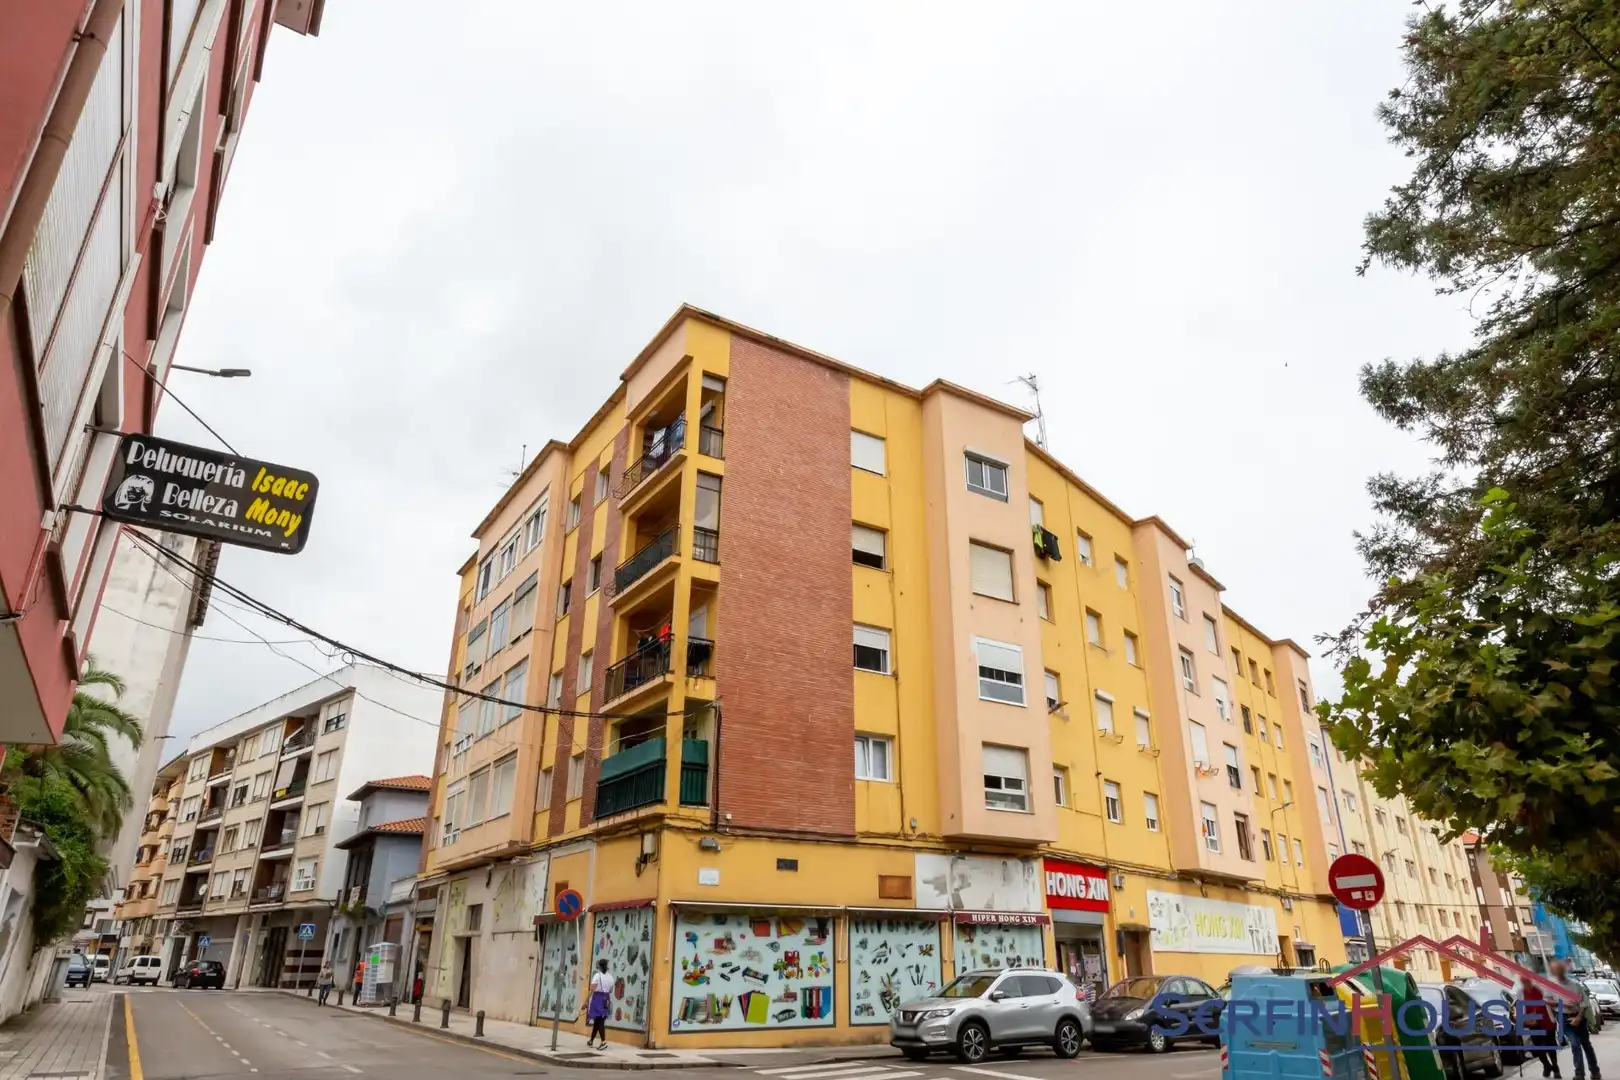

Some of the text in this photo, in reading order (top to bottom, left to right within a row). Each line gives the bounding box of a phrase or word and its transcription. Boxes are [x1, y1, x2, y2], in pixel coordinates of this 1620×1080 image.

[126, 441, 308, 500] Peluquería Isaac
[160, 510, 272, 537] SOLARIUM
[162, 482, 301, 537] Belleza Mony
[1046, 871, 1109, 901] HONG XIN
[971, 914, 1037, 923] HIPER HONG XIN
[1195, 912, 1227, 938] HONG
